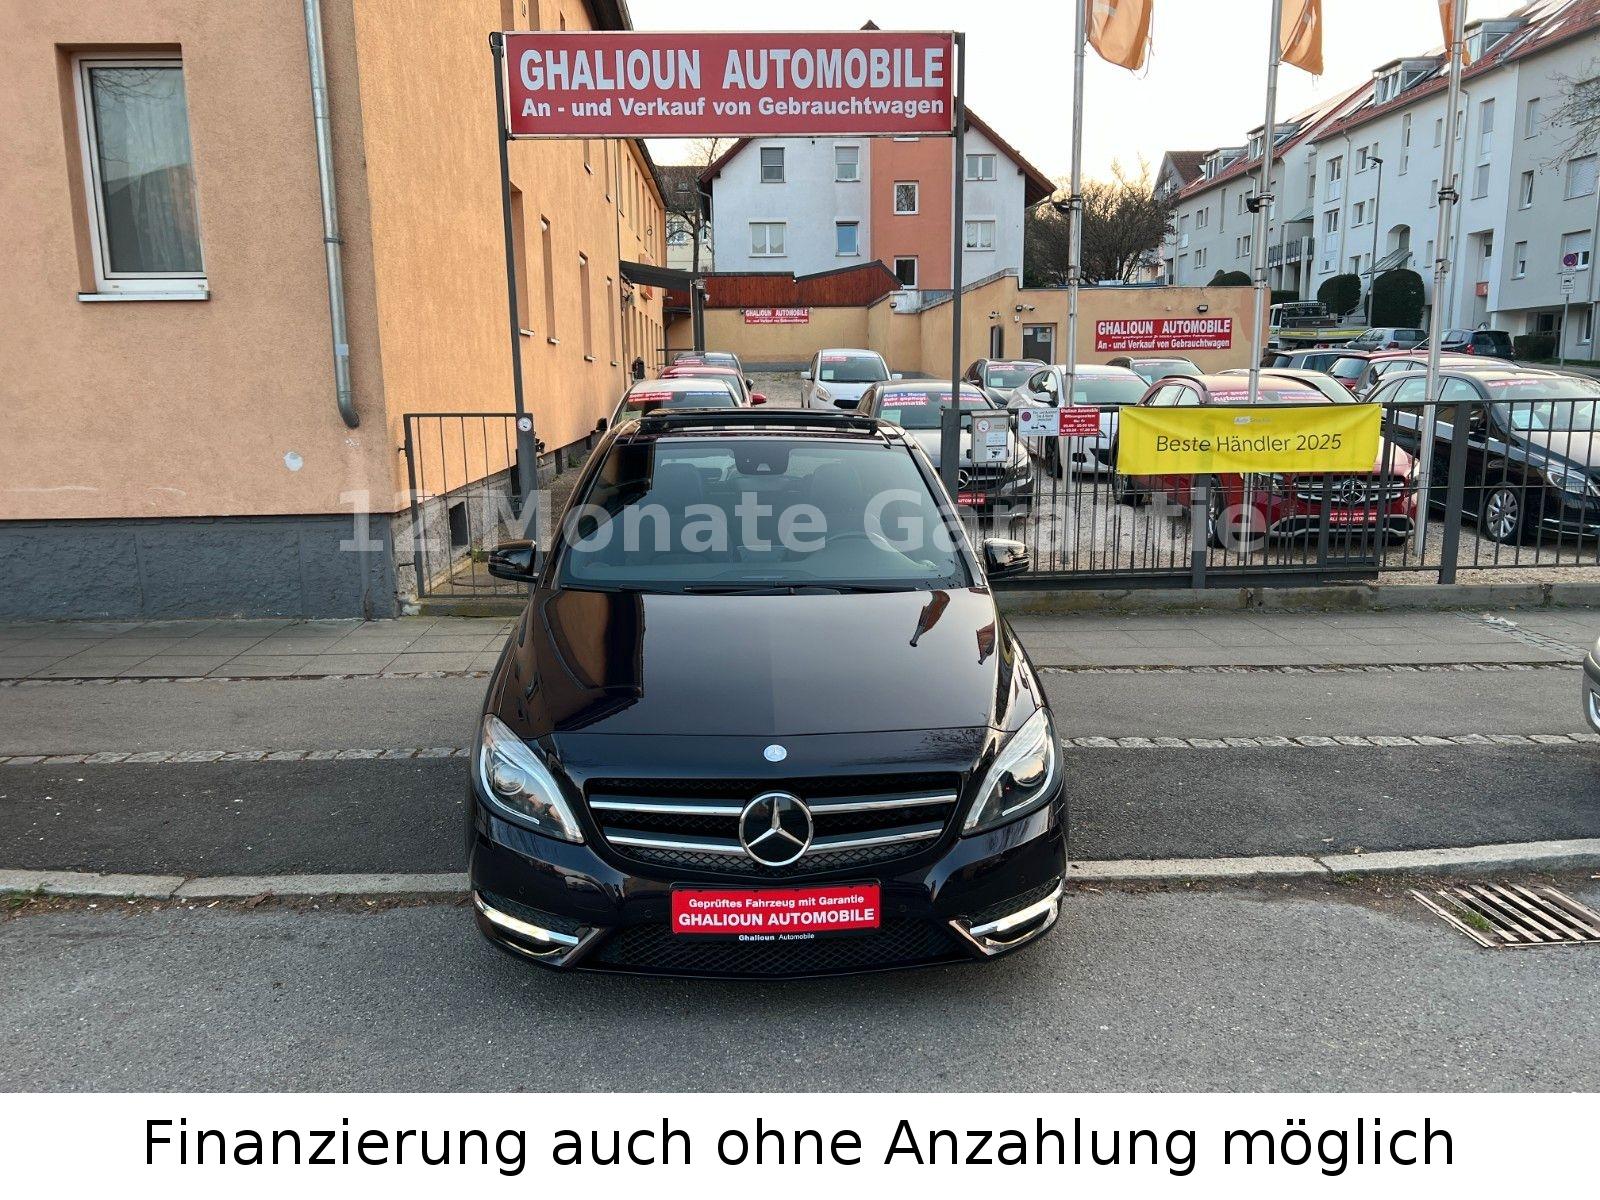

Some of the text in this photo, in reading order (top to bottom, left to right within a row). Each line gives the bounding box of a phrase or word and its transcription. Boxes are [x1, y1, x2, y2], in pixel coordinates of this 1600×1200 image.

[520, 48, 944, 91] GHALIOUN AUTOMOBILE
[522, 98, 551, 117] An
[572, 98, 612, 117] und
[618, 97, 705, 117] Verkauf
[713, 101, 751, 116] von
[758, 96, 944, 119] Gebrauchtwagen
[775, 309, 808, 317] AUTOMOBILE
[1098, 319, 1231, 335] GHALIOUN AUTOMOBILE
[1097, 340, 1107, 349] An
[1113, 340, 1126, 349] und
[1128, 339, 1155, 349] Verkauf
[1171, 338, 1230, 349] Gebrauchtwagen
[1156, 433, 1342, 452] Beste Händler 2025
[689, 894, 864, 910] Geprüftes Fahrzeug mit Garantie
[678, 908, 875, 927] GHALIOUN AUTOMOBILE
[778, 933, 815, 941] Automobile
